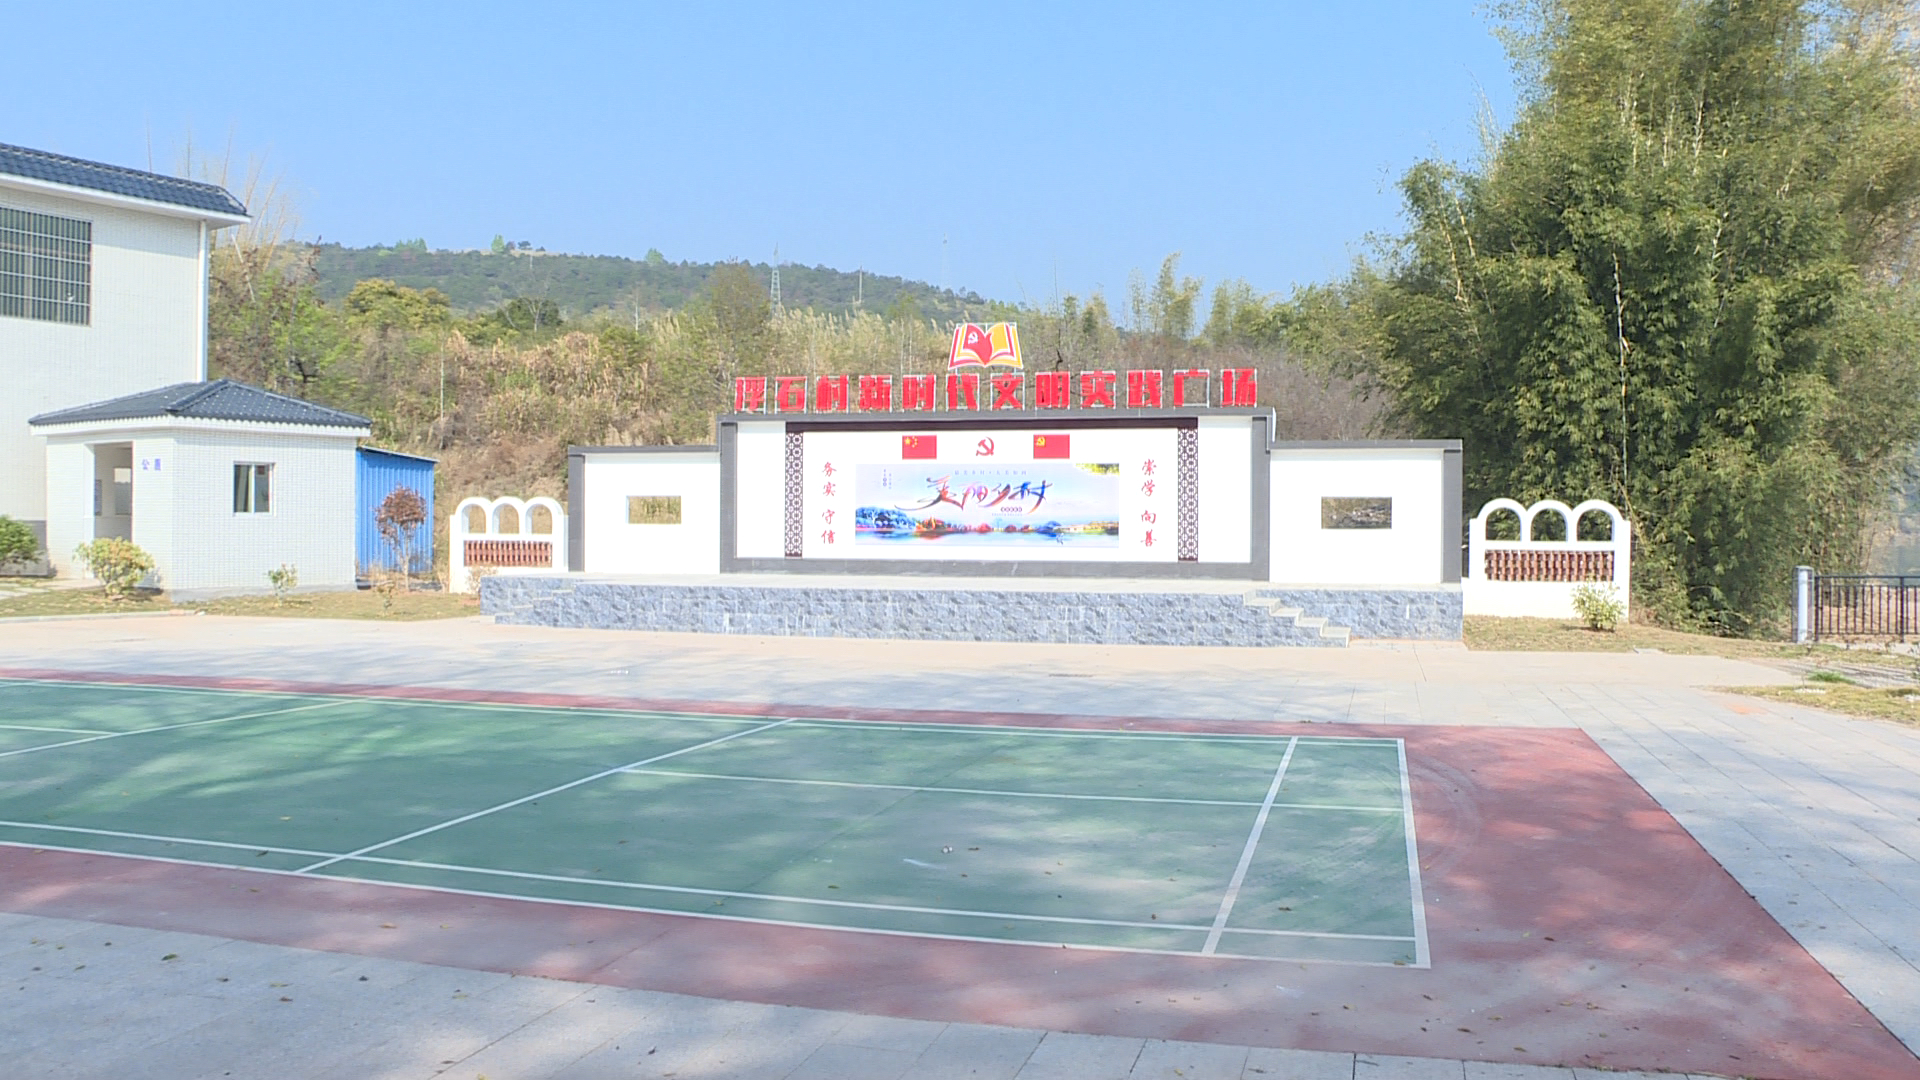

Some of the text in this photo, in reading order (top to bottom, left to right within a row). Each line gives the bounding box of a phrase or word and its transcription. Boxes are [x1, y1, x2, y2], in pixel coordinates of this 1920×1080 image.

[735, 368, 1258, 411] 浮石村新时代文明实践广场
